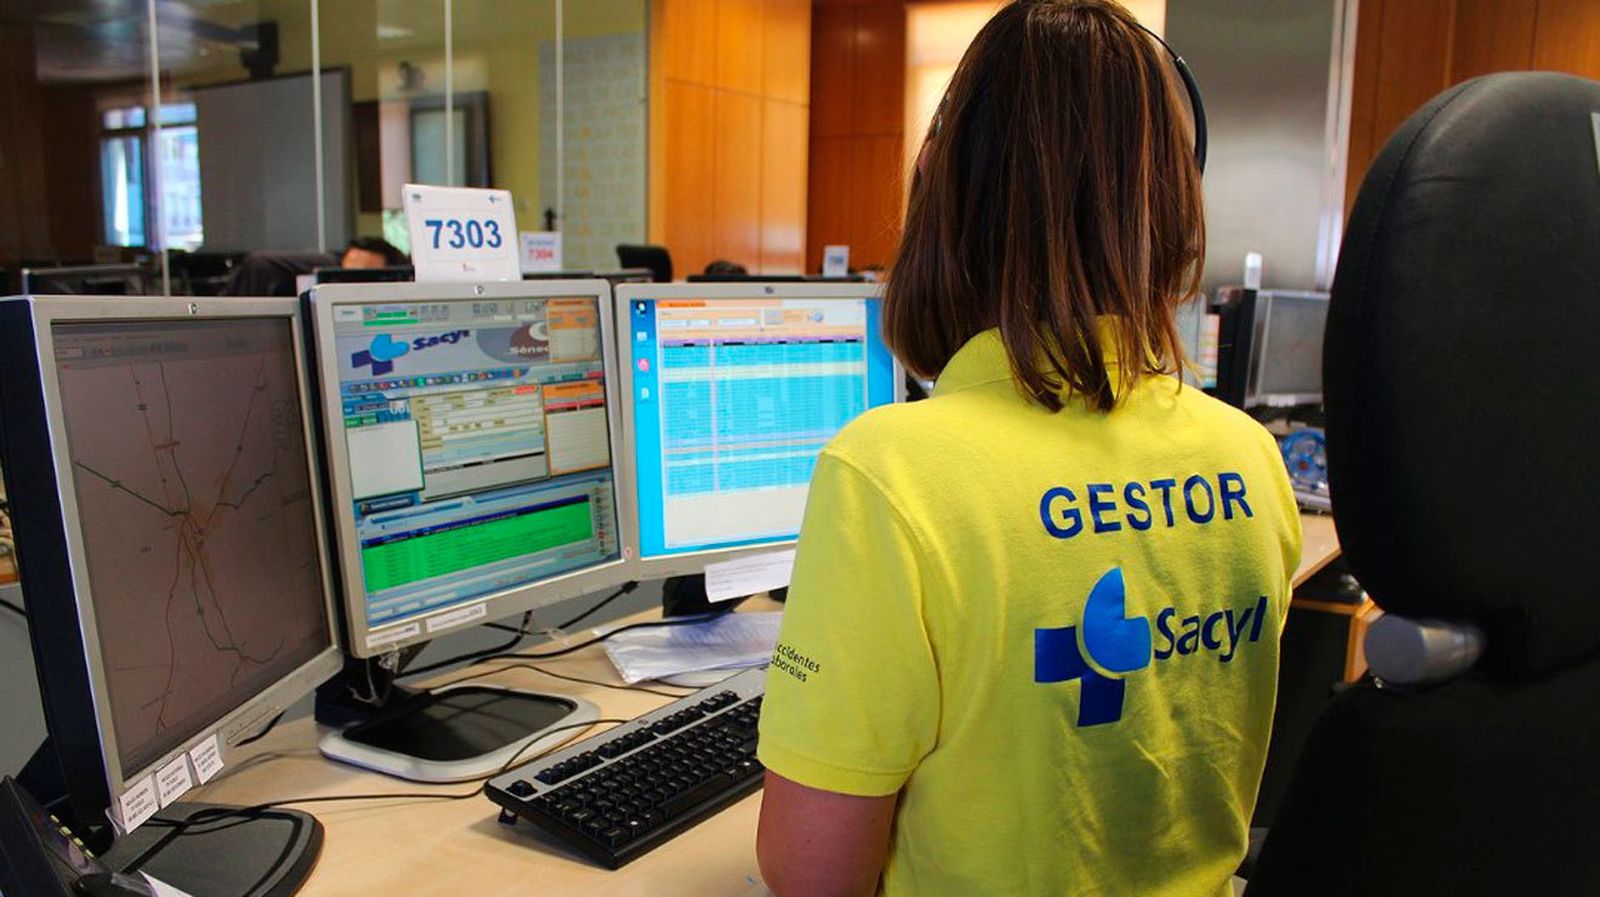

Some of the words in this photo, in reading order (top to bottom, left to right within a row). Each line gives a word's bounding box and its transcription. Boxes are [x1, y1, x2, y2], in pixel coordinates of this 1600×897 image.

[425, 219, 502, 249] 7303
[1040, 472, 1253, 539] GESTOR
[1154, 596, 1267, 662] Sacyl
[776, 643, 820, 673] ccidentes
